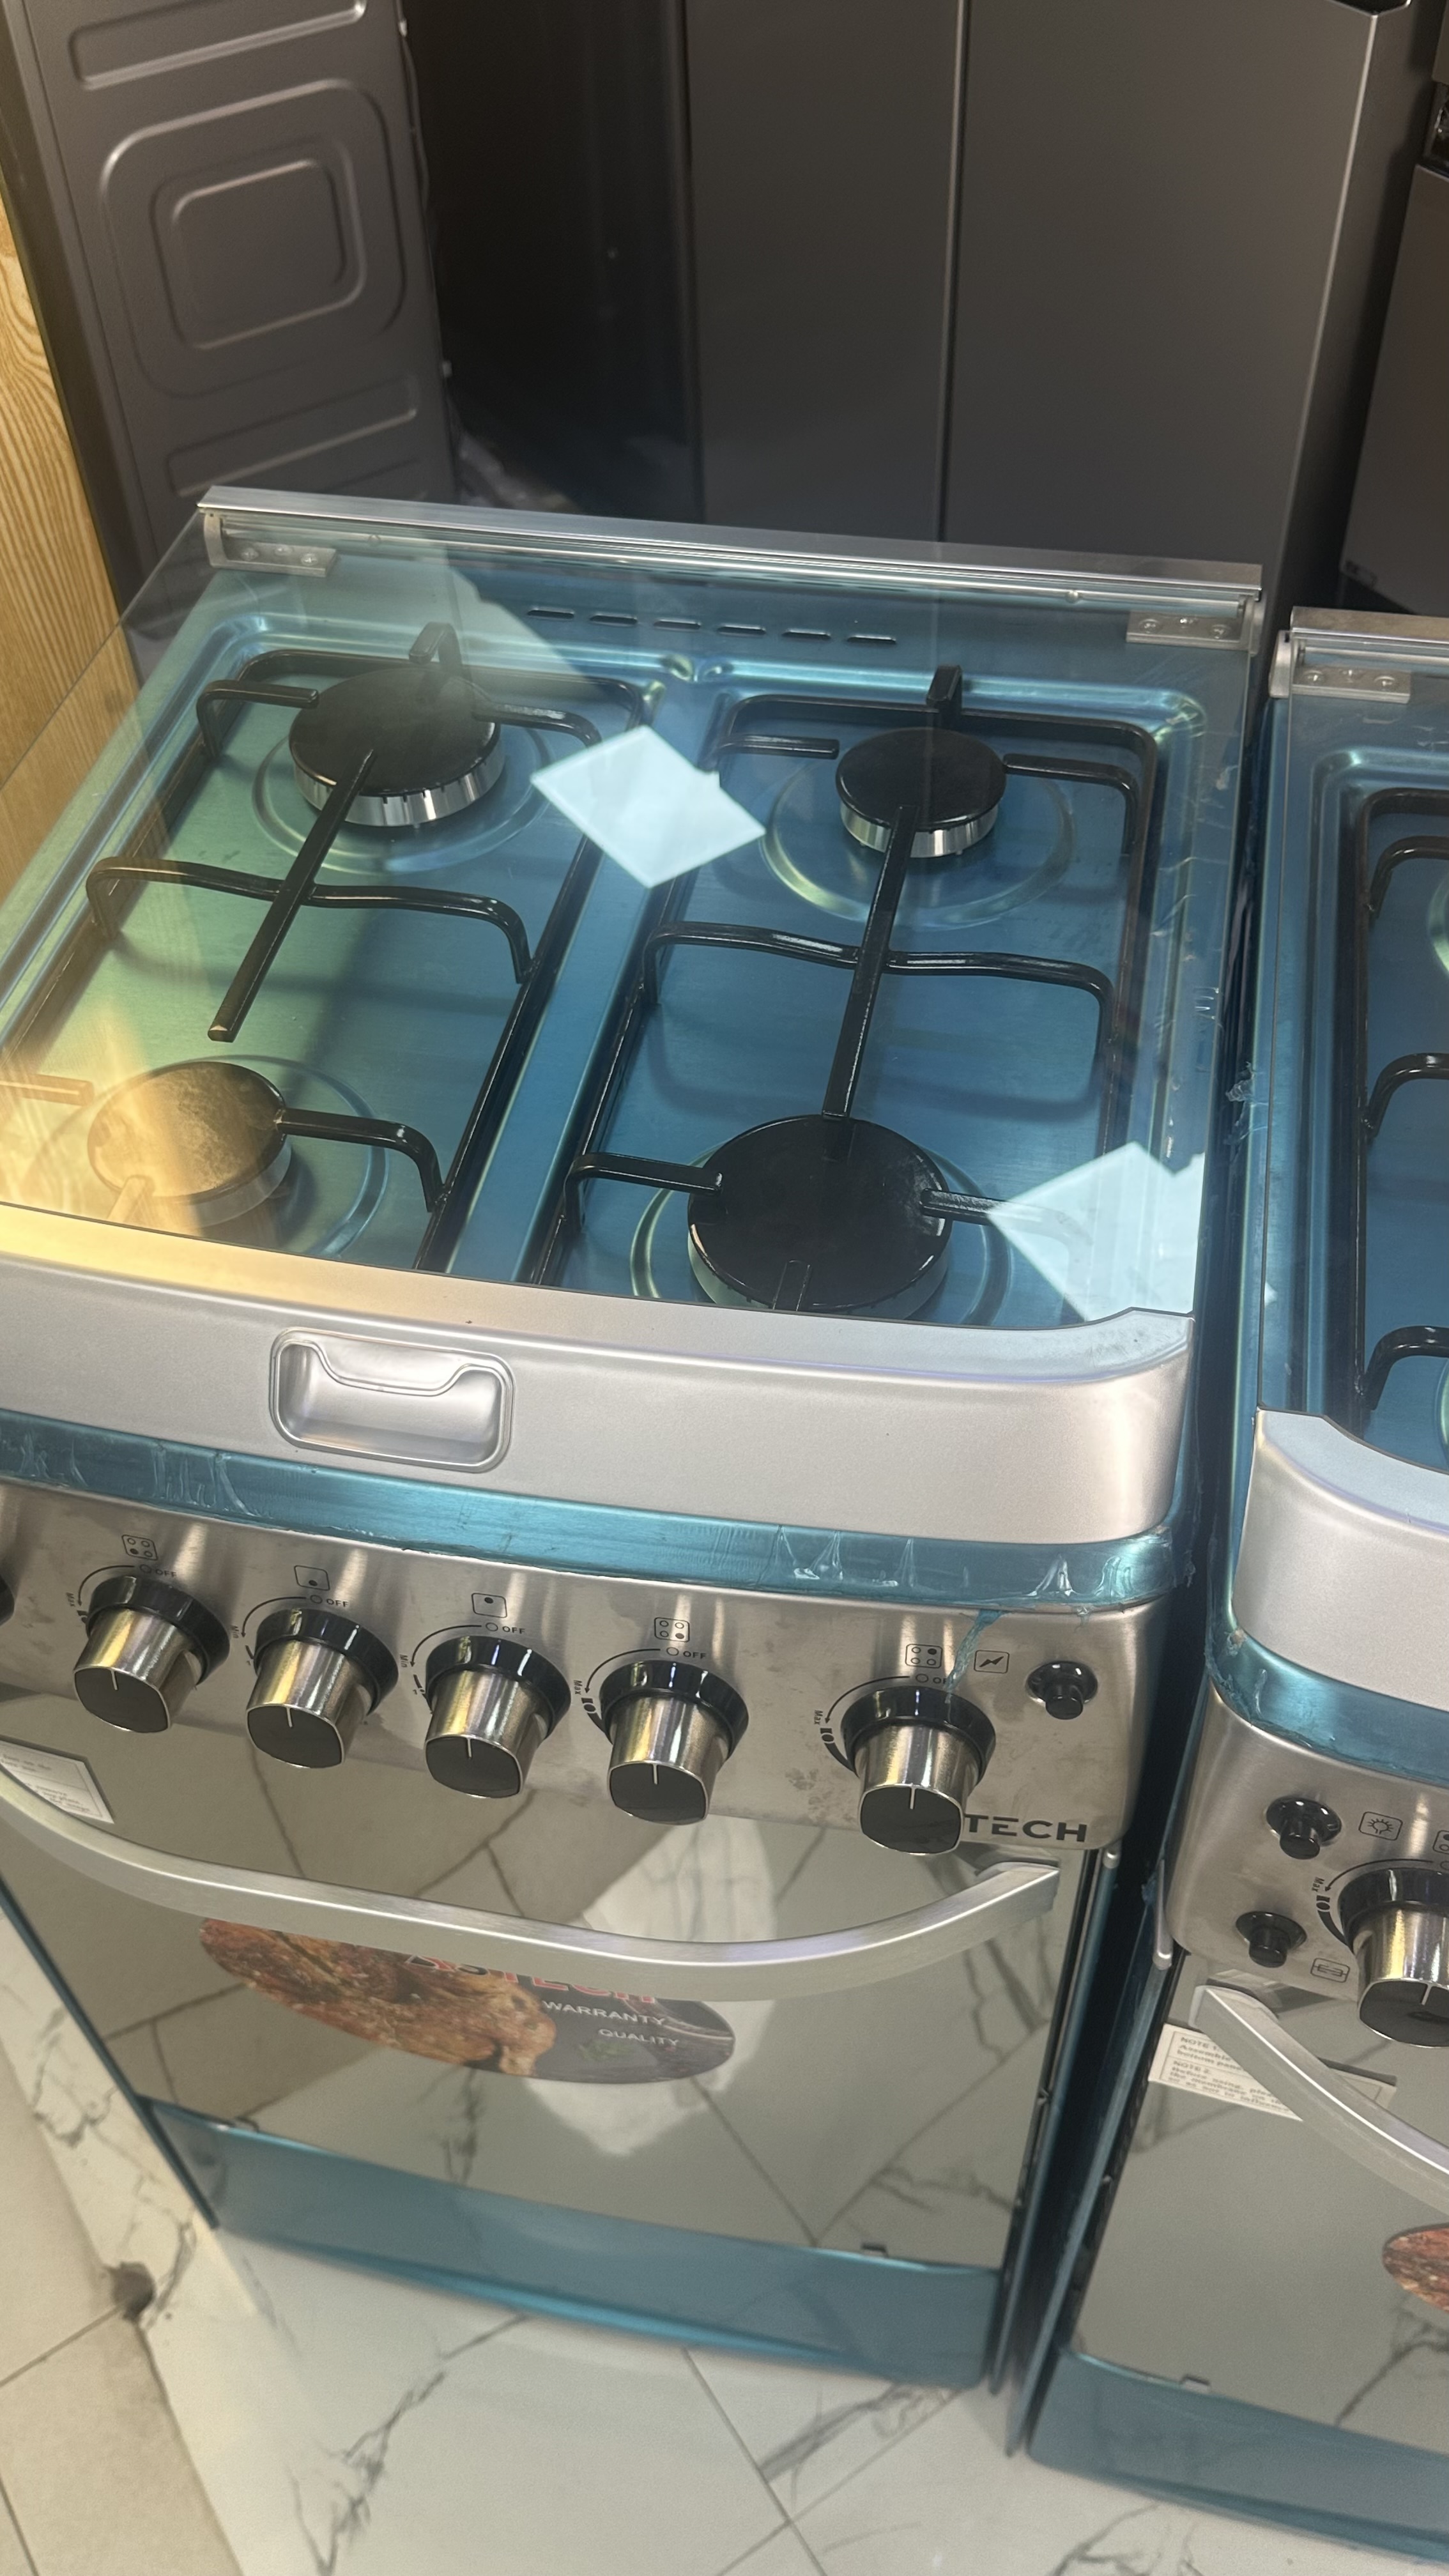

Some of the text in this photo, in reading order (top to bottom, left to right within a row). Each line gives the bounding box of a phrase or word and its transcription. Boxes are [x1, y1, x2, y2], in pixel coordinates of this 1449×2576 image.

[155, 1568, 177, 1577] OFF
[326, 1598, 349, 1607] OFF
[502, 1626, 526, 1634] OFF
[399, 1653, 408, 1668] Min
[682, 1650, 707, 1660] OFF
[573, 1679, 583, 1696] Max
[814, 1709, 824, 1725] Max
[1312, 1876, 1326, 1892] Max
[542, 2000, 665, 2026] WARRANTY
[597, 2028, 679, 2046] QUALITY
